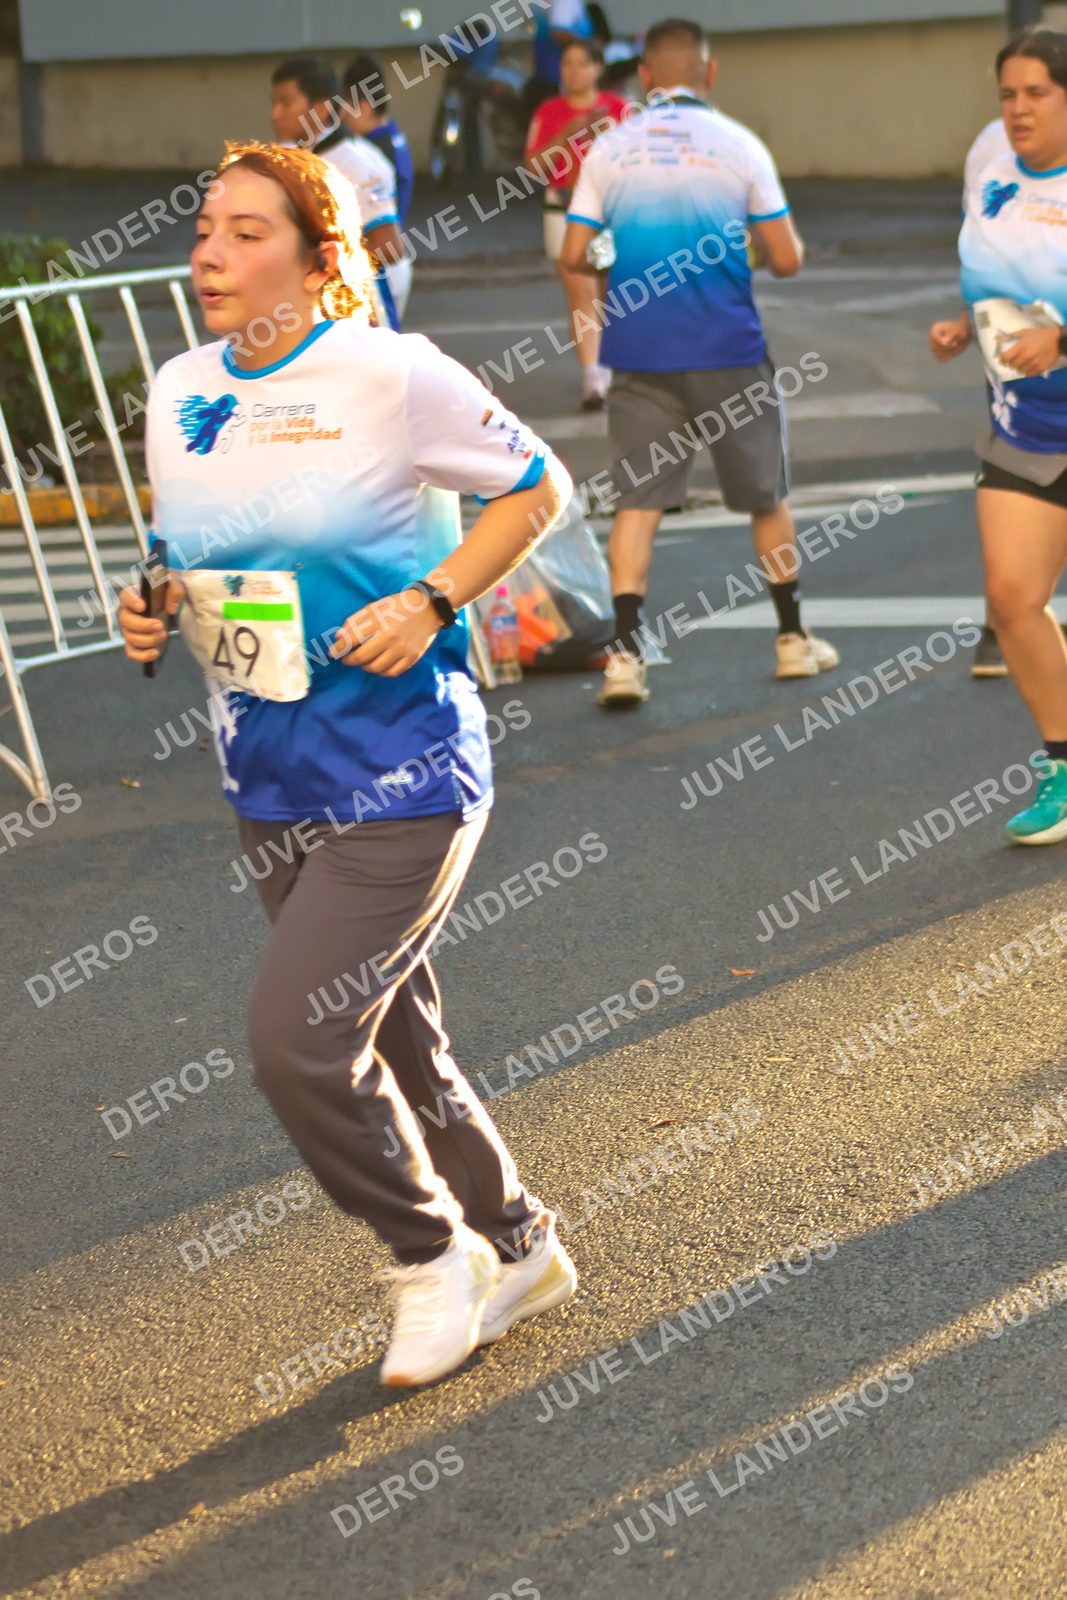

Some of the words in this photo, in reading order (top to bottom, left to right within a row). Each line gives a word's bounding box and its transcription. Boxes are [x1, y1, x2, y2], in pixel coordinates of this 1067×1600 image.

[285, 416, 316, 429] Vida
[270, 427, 343, 444] Integridad
[212, 626, 261, 678] 49
